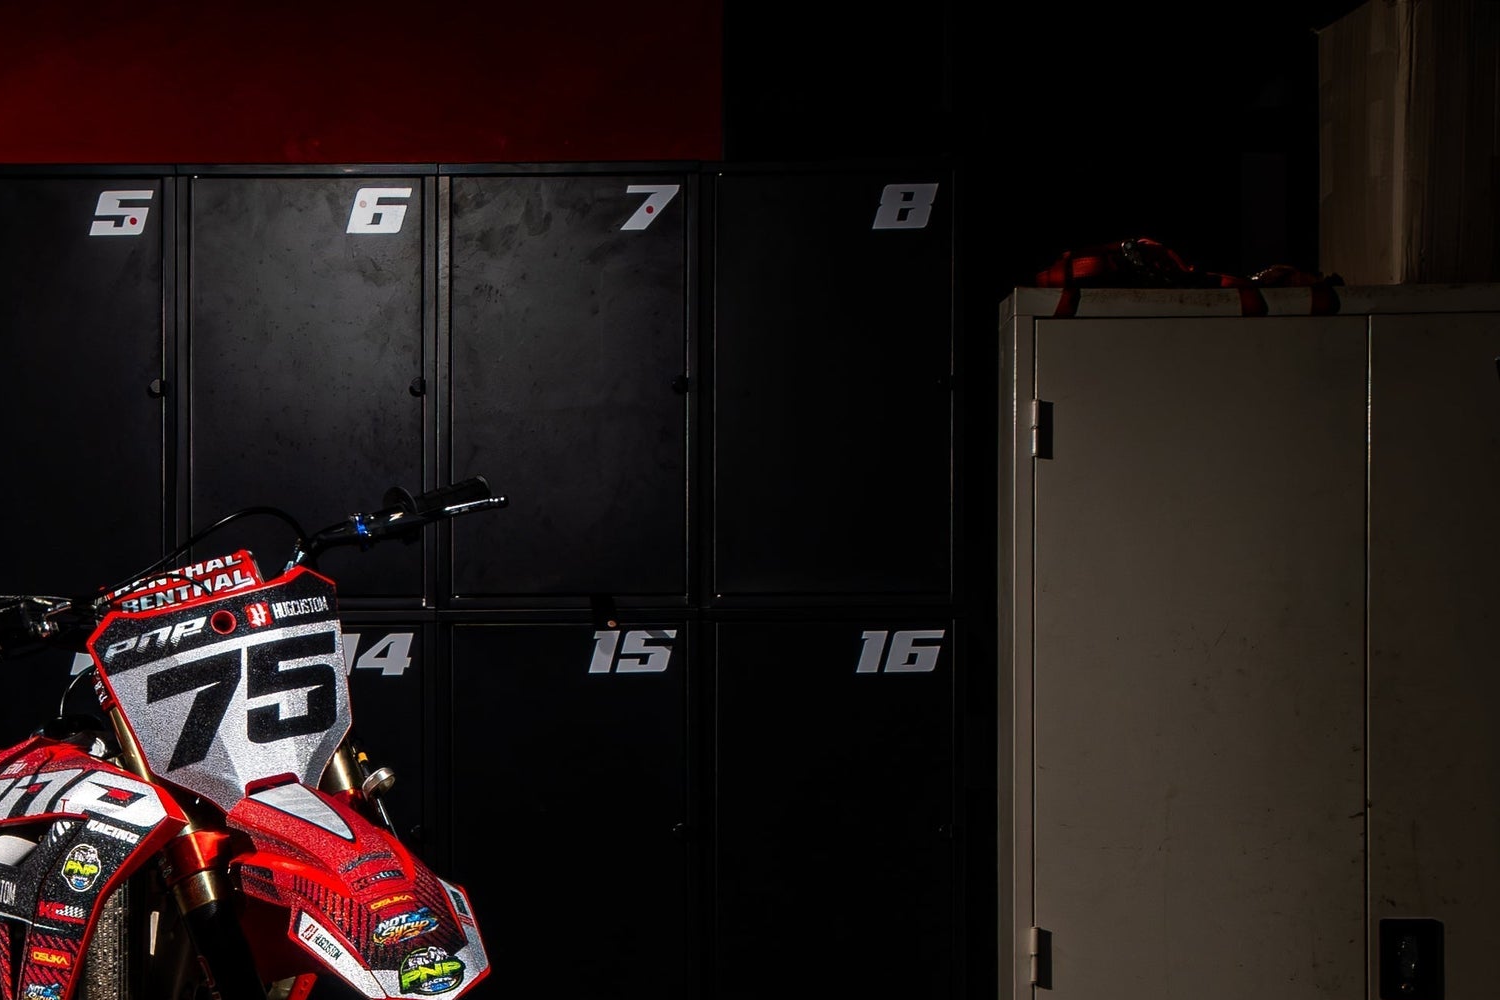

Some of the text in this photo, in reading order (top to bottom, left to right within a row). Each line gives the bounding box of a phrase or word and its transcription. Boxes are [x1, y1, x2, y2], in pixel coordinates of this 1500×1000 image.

[90, 191, 153, 236] 5
[347, 188, 412, 234] 6
[621, 185, 680, 230] 7
[873, 184, 939, 230] 8
[121, 569, 252, 613] RENTHAL
[273, 596, 329, 619] HUGCUSTOM
[589, 630, 678, 674] 15
[856, 629, 946, 673] 16
[146, 630, 337, 771] 75
[86, 819, 140, 844] RACING
[65, 860, 99, 876] PNP
[402, 961, 461, 989] PNP
